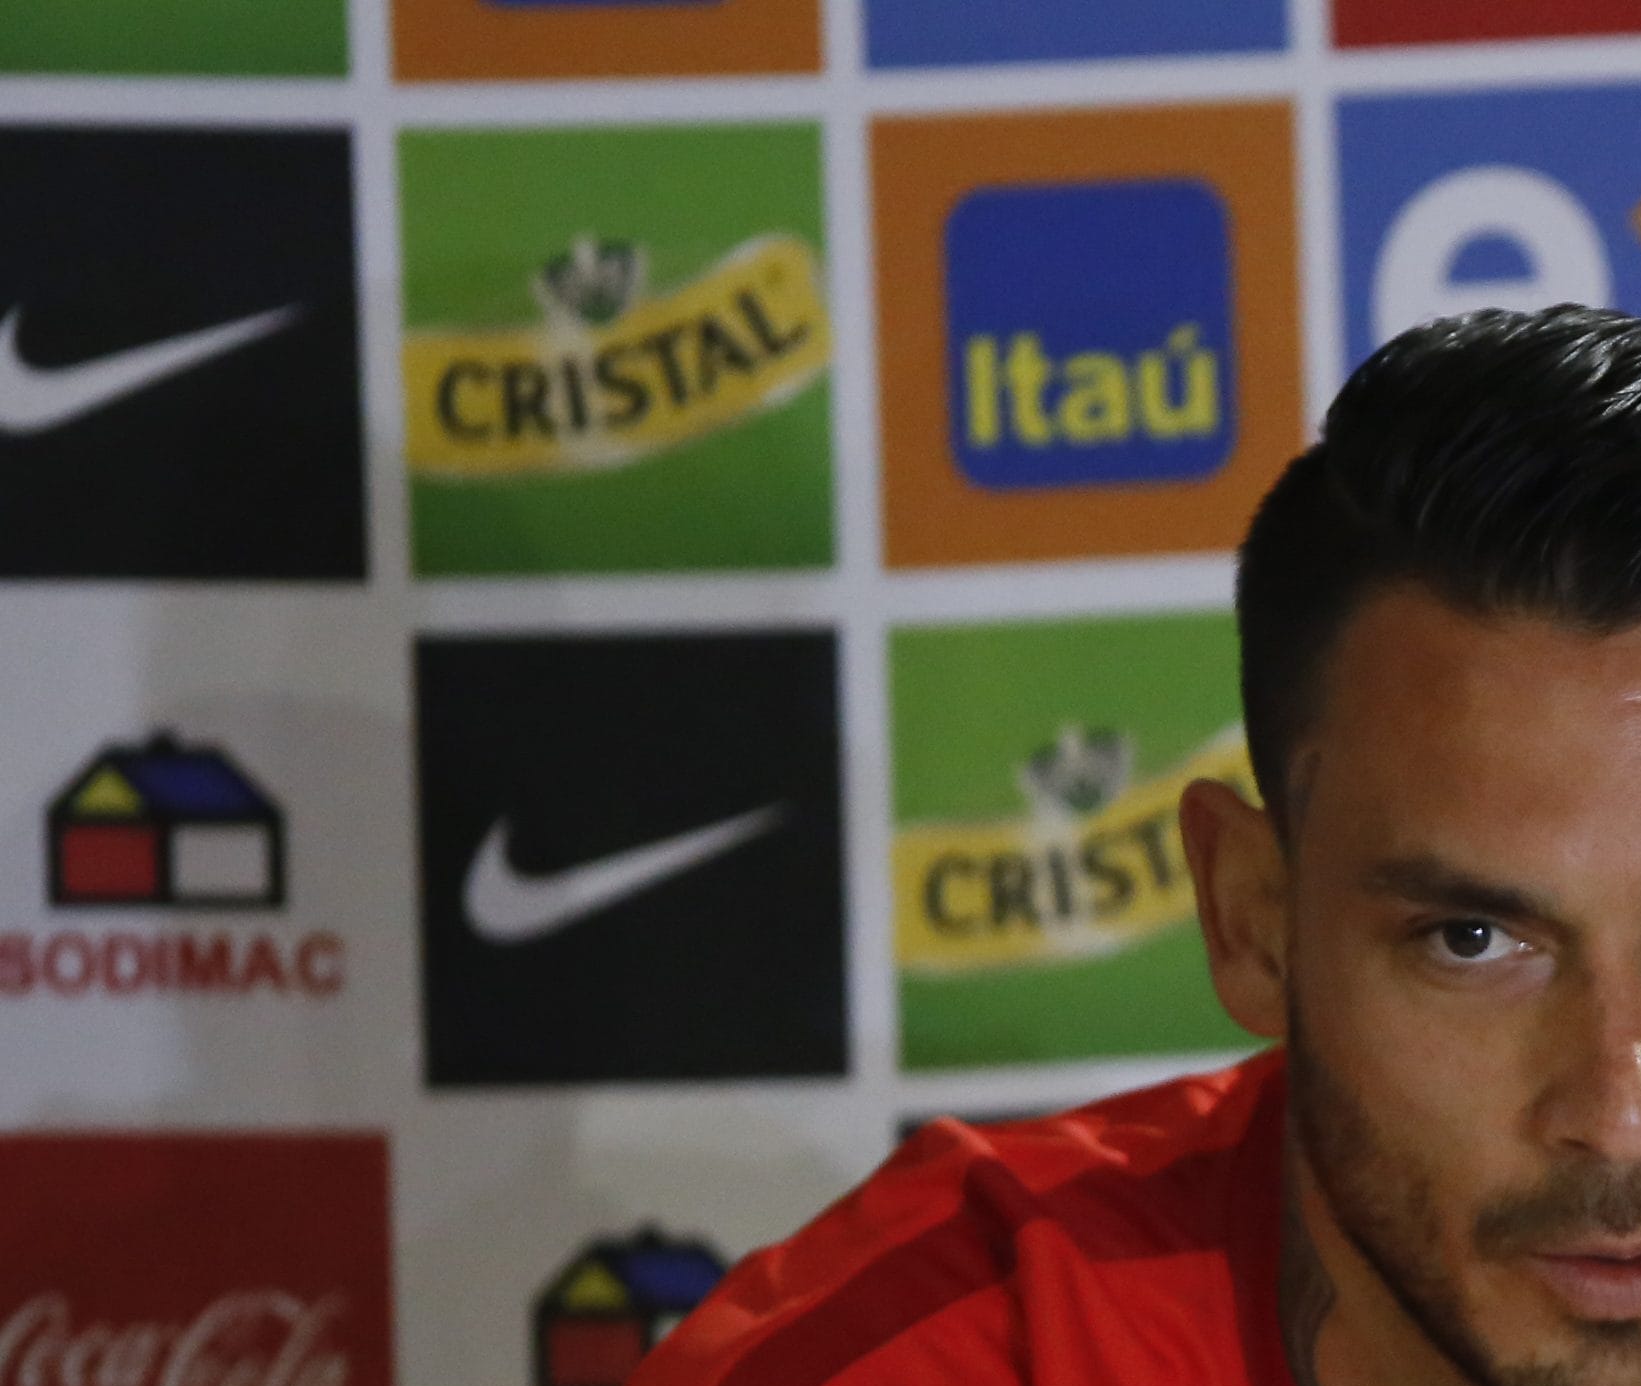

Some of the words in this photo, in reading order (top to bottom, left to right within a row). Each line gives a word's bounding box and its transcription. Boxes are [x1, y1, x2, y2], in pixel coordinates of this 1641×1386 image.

[434, 286, 812, 446] CRISTAL
[963, 324, 1220, 449] Itaú
[921, 816, 1176, 940] CRIST
[0, 930, 345, 996] SODIMAC
